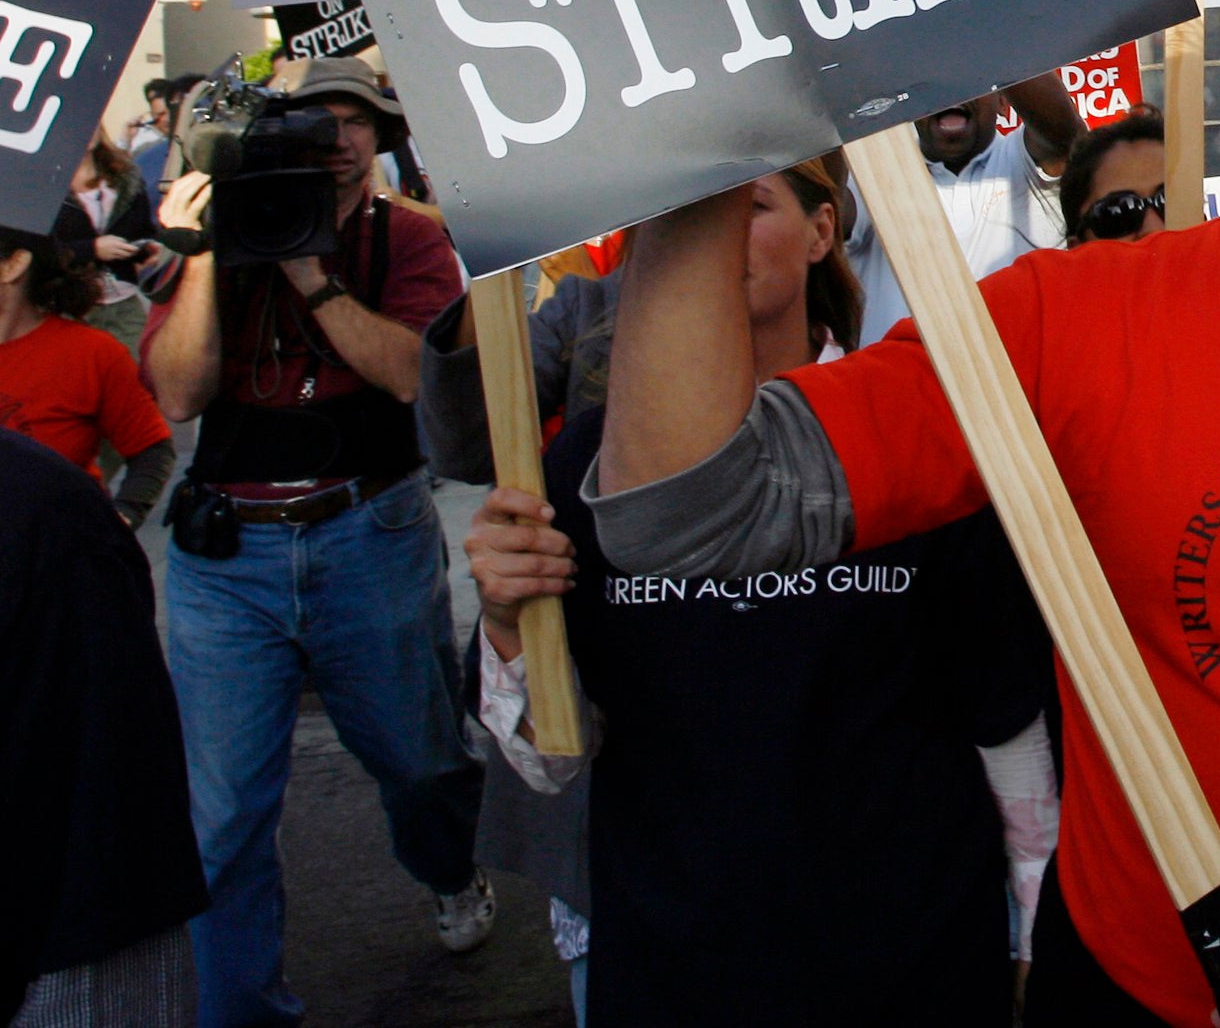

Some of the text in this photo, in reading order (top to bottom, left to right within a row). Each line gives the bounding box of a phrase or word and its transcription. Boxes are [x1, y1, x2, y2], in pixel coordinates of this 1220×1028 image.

[1087, 67, 1119, 89] OF
[1072, 87, 1131, 119] ICA
[827, 566, 910, 593] GUILD
